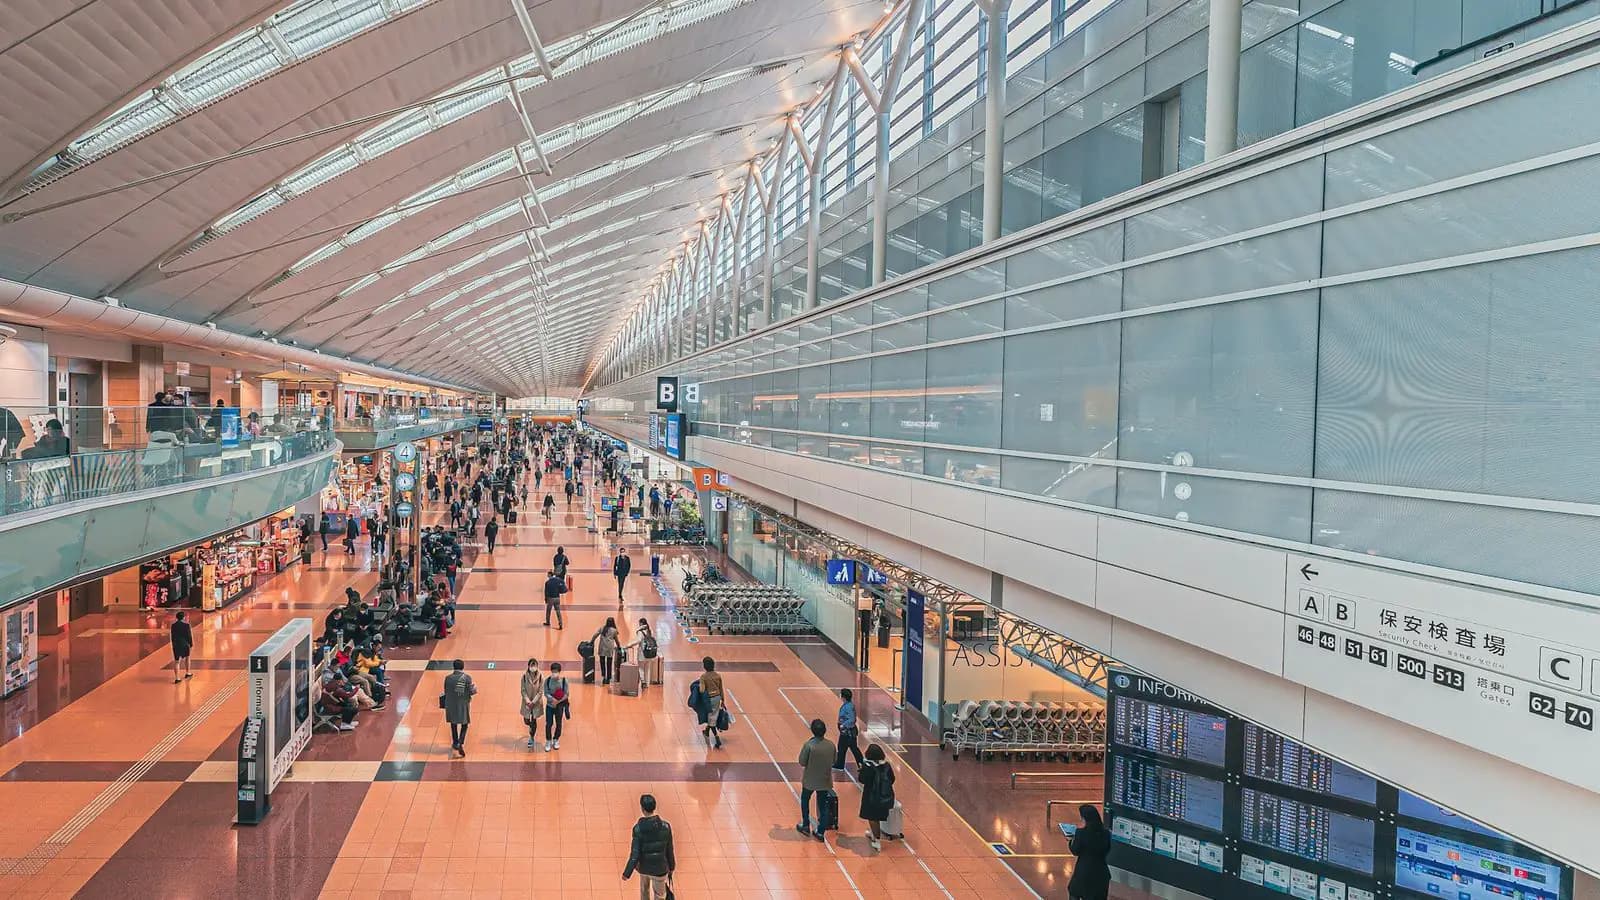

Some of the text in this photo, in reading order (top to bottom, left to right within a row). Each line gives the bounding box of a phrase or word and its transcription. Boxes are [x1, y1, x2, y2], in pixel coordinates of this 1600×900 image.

[661, 383, 674, 403] B
[400, 446, 409, 459] 4
[703, 473, 712, 486] B
[1304, 596, 1348, 621] A B
[1378, 630, 1438, 651] Security Check
[1379, 608, 1505, 656] 保安検査場
[1299, 628, 1463, 687] 46 48 51 61 500 513
[1550, 658, 1571, 680] C
[1137, 678, 1208, 705] INFOR
[1480, 690, 1511, 706] Gates
[1531, 696, 1592, 726] 62 70
